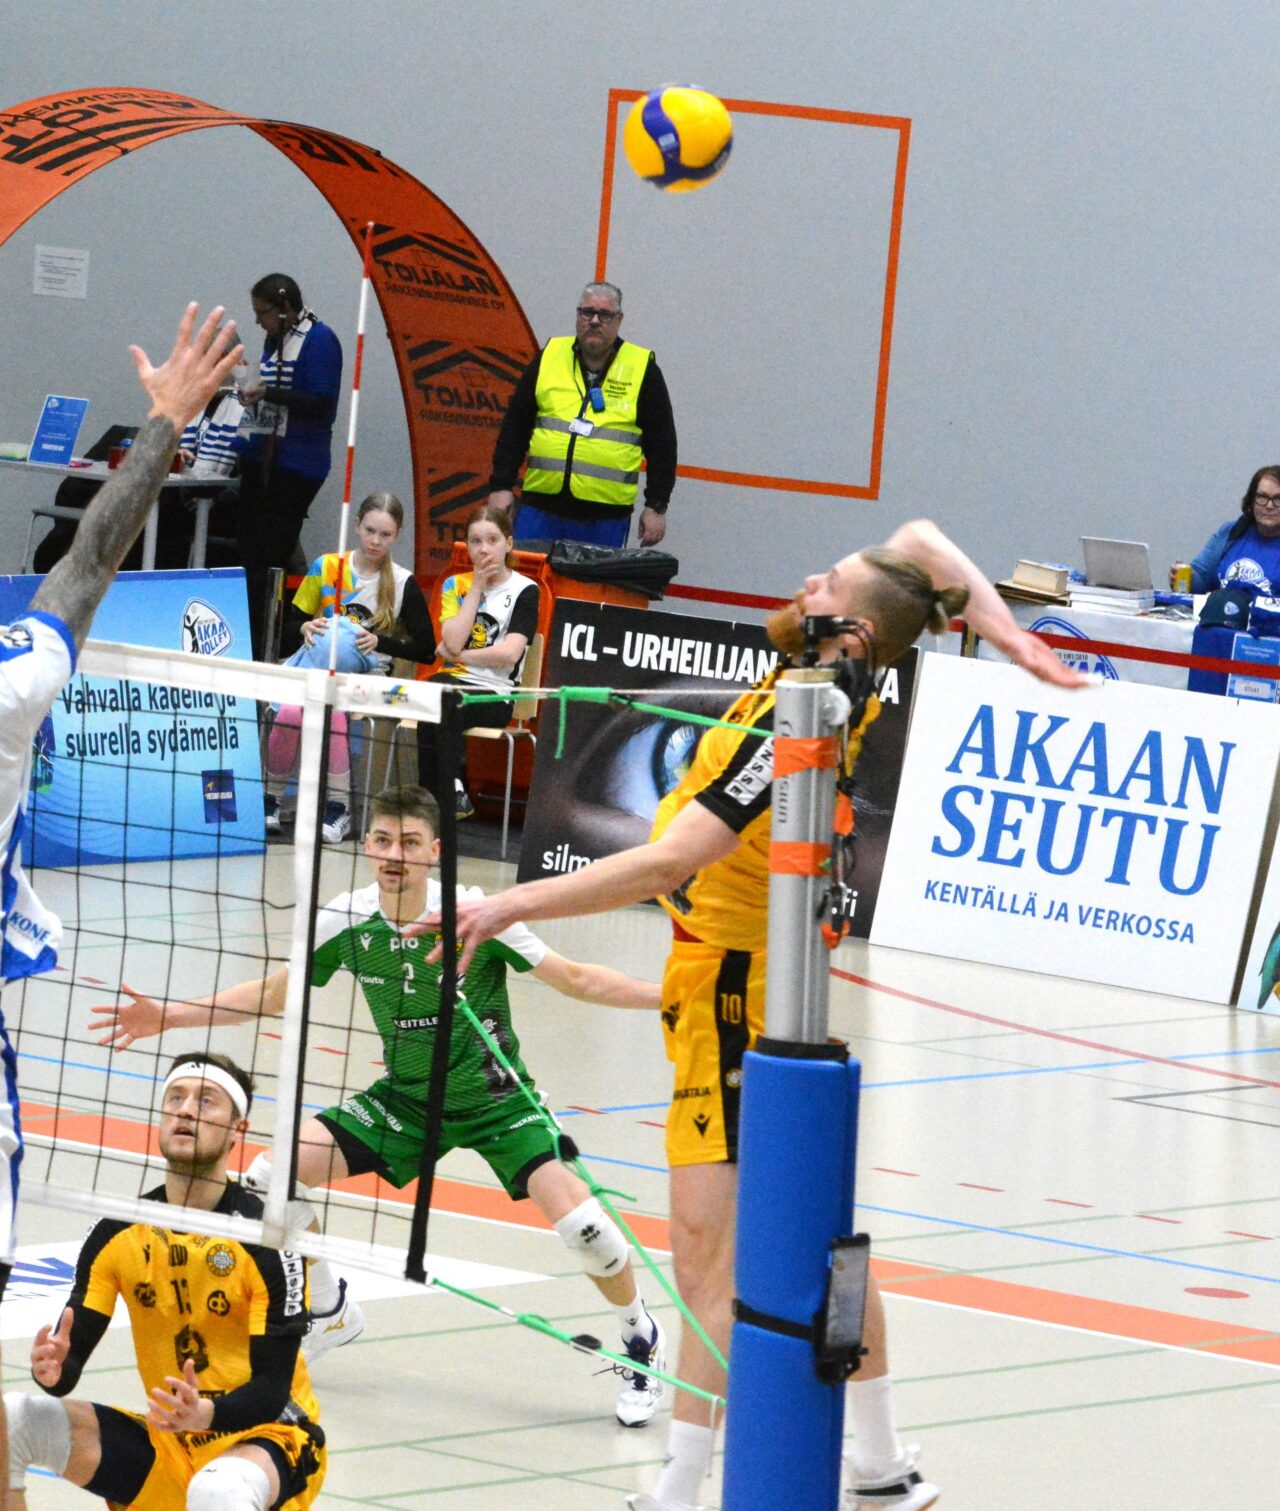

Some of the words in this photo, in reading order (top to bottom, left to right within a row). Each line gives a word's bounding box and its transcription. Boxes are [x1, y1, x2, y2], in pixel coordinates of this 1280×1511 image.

[504, 594, 512, 607] 5
[561, 623, 598, 662] ICL
[622, 630, 778, 688] URHEILIJAN
[62, 680, 141, 714] Vahvalla
[65, 722, 141, 758] suurella
[148, 717, 240, 761] sydämellä
[946, 703, 1237, 815] AKAAN
[930, 784, 1221, 896] SEUTU
[924, 878, 1037, 919] KENTÄLLÄ
[1043, 898, 1070, 923] JA
[1077, 902, 1196, 945] VERKOSSA
[390, 936, 420, 952] pro
[720, 993, 742, 1025] 10
[283, 1250, 300, 1313] ONSSE
